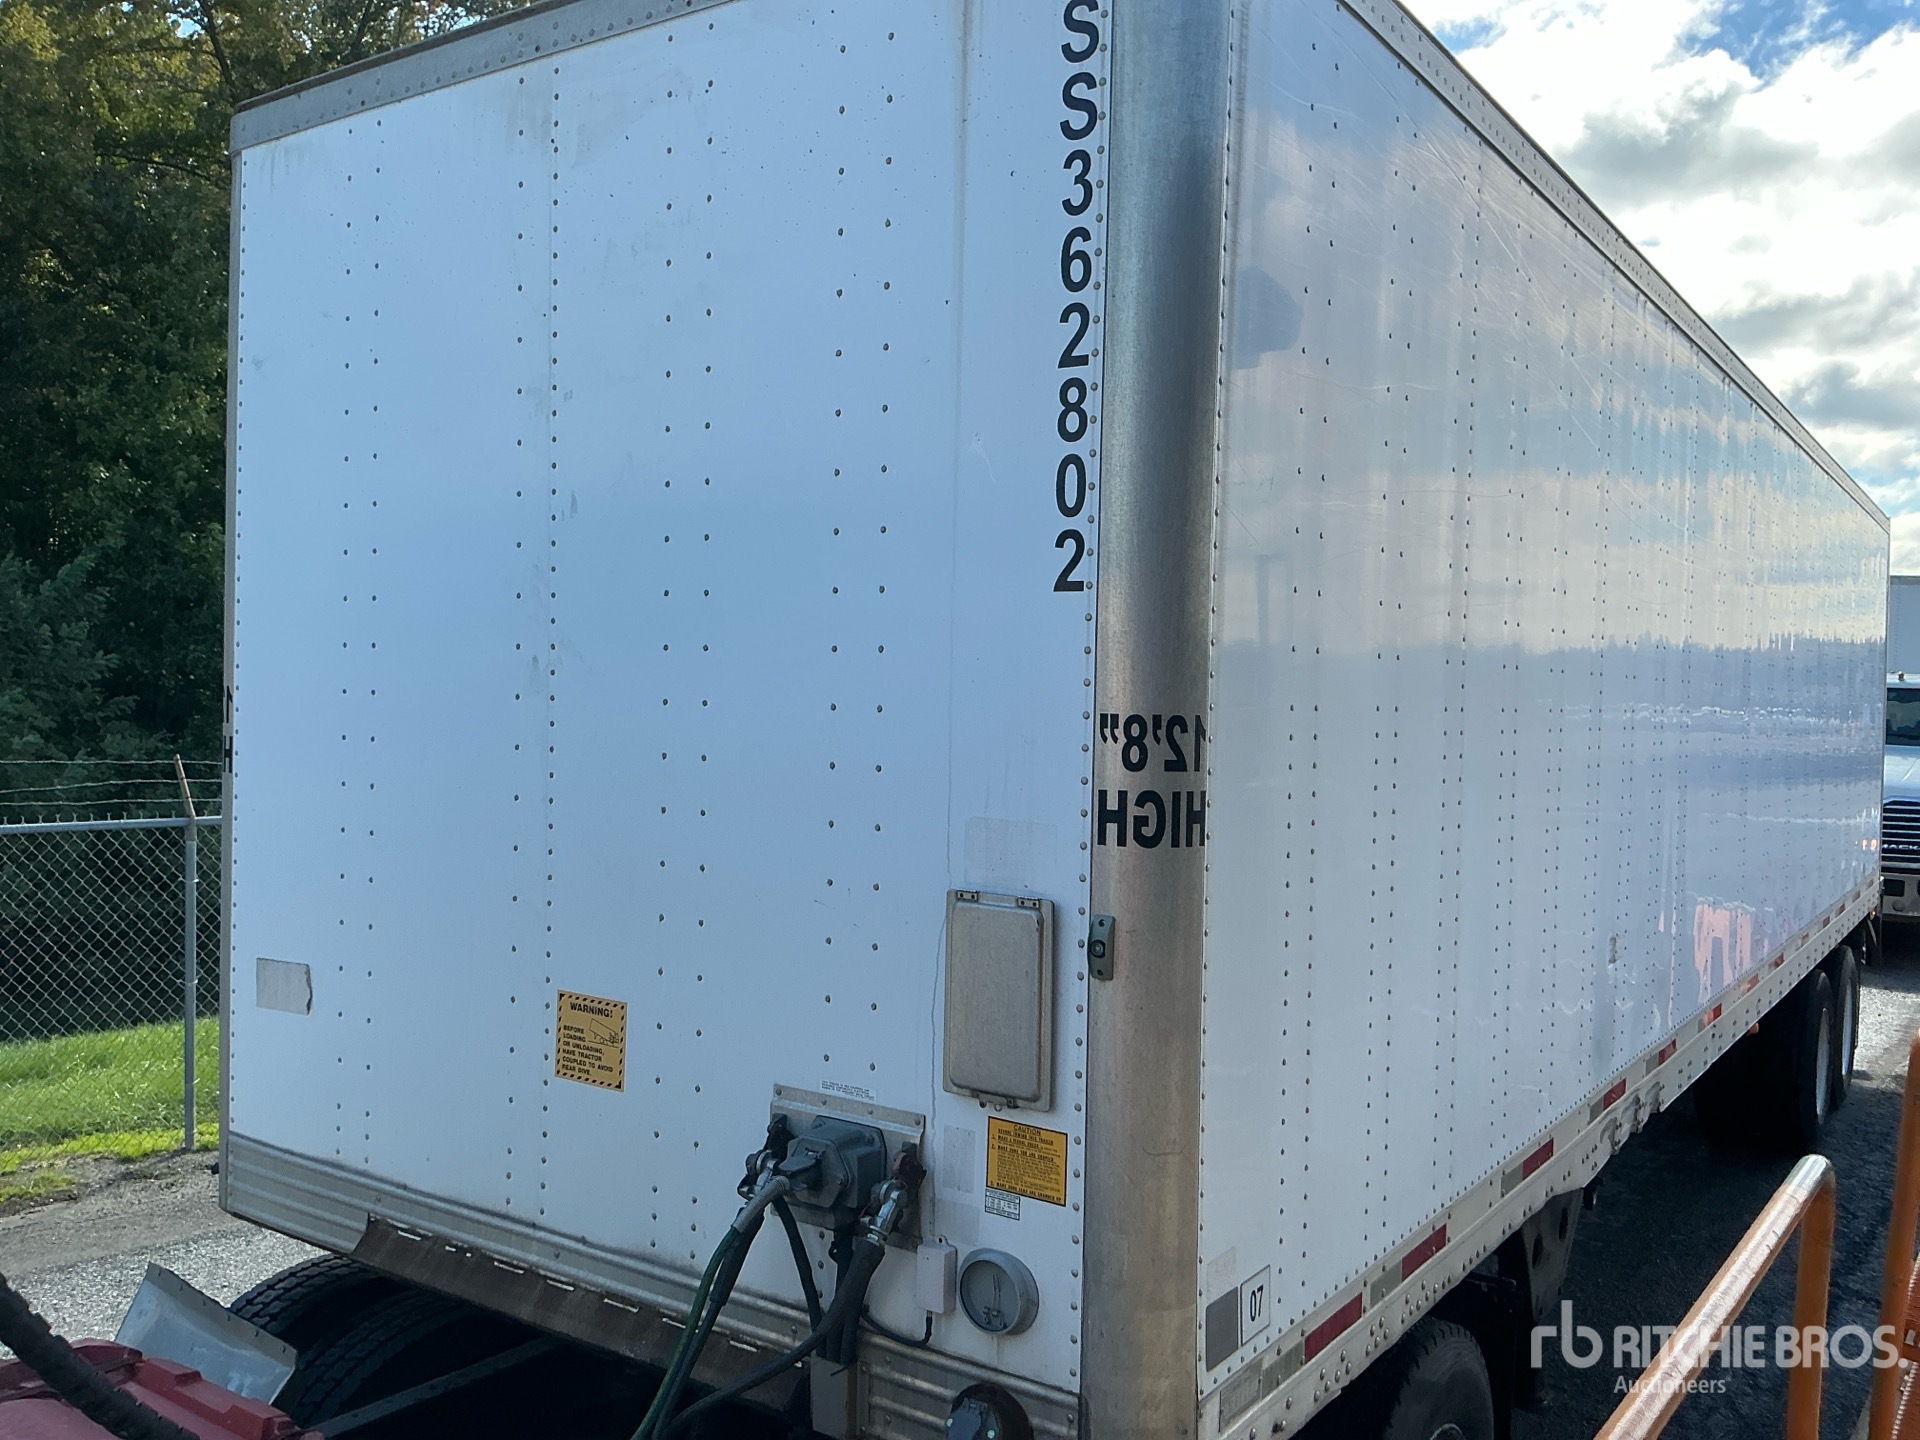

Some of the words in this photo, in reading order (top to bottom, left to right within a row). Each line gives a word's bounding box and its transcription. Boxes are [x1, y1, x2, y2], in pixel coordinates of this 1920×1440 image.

[1053, 0, 1100, 592] SS362802
[570, 1002, 613, 1018] WARNING!
[563, 1025, 584, 1034] BEFORE
[563, 1033, 586, 1042] LOADING
[562, 1048, 575, 1056] HAVE
[578, 1051, 602, 1062] TRACTOR
[562, 1056, 586, 1066] COUPLED
[597, 1064, 614, 1072] AVOID
[562, 1064, 576, 1072] REAR
[1014, 1125, 1041, 1137] CAUTION
[1250, 1284, 1264, 1322] 07
